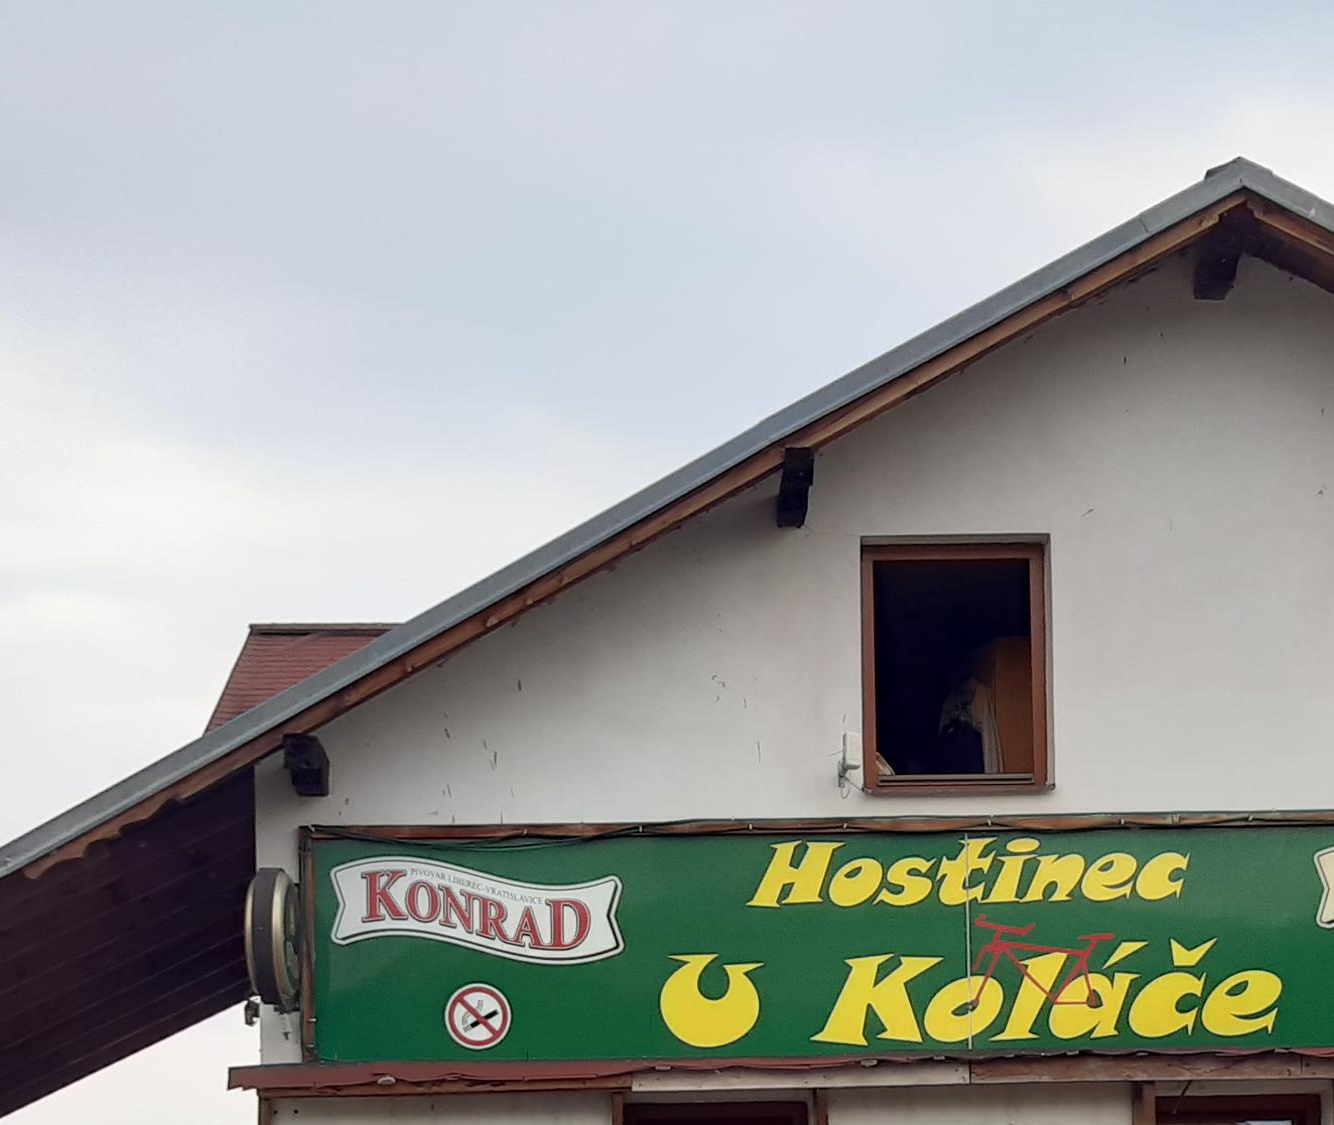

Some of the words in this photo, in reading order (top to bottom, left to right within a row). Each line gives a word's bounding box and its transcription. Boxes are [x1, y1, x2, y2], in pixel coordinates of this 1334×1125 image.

[361, 868, 591, 950] KONRAD
[410, 868, 446, 880] PIVOVAR
[746, 836, 1191, 908] Hostinec
[659, 952, 764, 1048] U
[809, 936, 1283, 1046] Koláče
